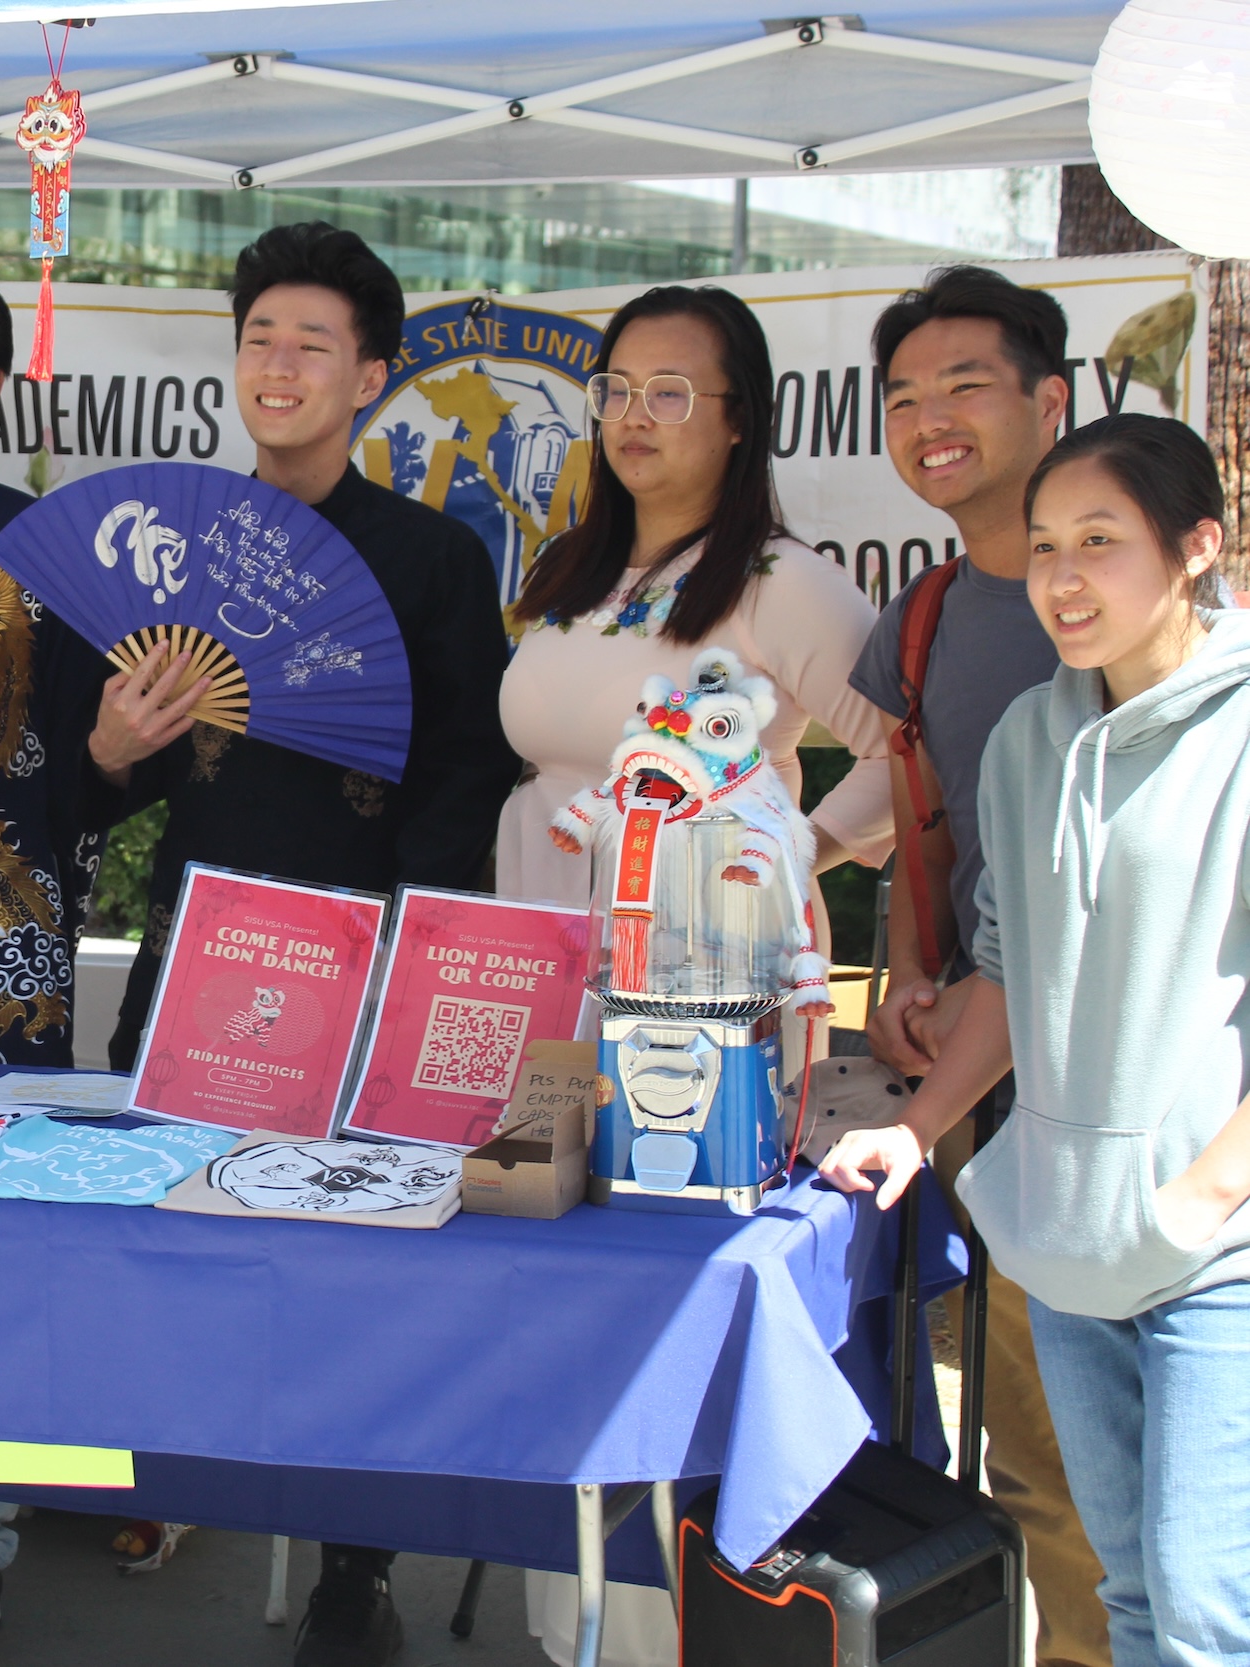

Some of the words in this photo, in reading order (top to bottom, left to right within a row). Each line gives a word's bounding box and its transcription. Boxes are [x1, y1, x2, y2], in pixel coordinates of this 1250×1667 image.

[422, 317, 509, 356] STATE
[627, 816, 651, 896] 招財進寶
[244, 916, 263, 926] SJSU
[265, 919, 281, 929] VSA
[283, 923, 320, 936] Presents!
[217, 927, 279, 951] COME
[284, 939, 335, 961] JOIN
[458, 934, 478, 944] SJSU
[480, 937, 496, 945] VSA
[498, 939, 535, 950] Presents!
[203, 941, 256, 964] LION
[261, 953, 341, 980] DANCE!
[426, 945, 478, 966] LION
[485, 953, 558, 976] DANCE
[438, 966, 472, 985] QR
[478, 971, 538, 992] CODE
[186, 1049, 230, 1067] FRIDAY
[234, 1057, 305, 1080] PRACTICES
[221, 1073, 237, 1082] 5PM
[245, 1077, 261, 1087] 7PM
[204, 1093, 242, 1105] EXPERIENCE
[243, 1100, 277, 1111] REQUIRED!
